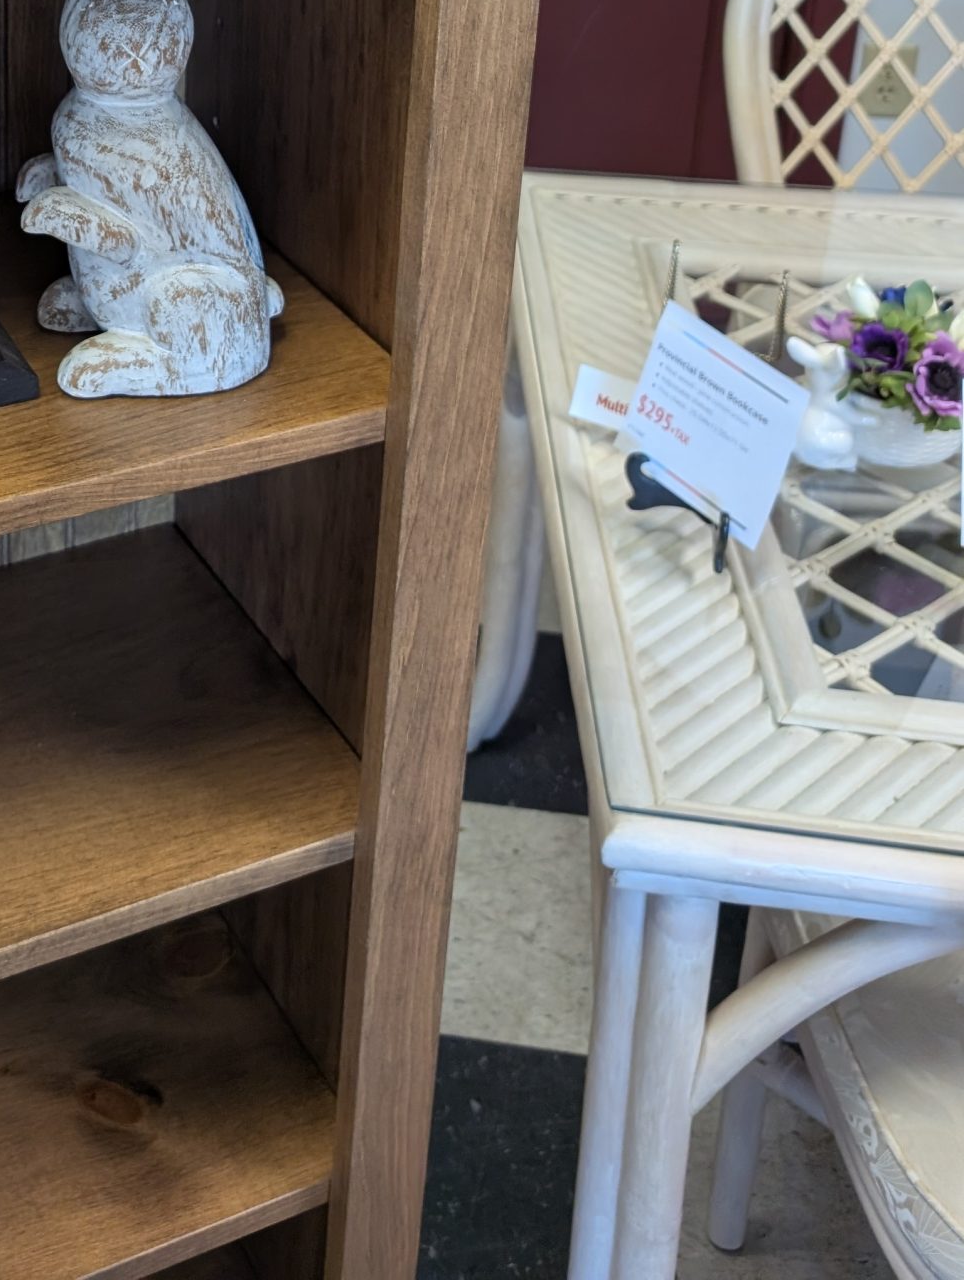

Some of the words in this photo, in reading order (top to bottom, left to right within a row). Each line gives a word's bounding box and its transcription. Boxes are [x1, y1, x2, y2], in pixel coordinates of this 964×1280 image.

[656, 341, 699, 377] Provincial
[697, 370, 727, 396] Brown
[725, 390, 769, 426] Bookcase
[595, 392, 631, 417] Multi
[636, 393, 675, 433] $295
